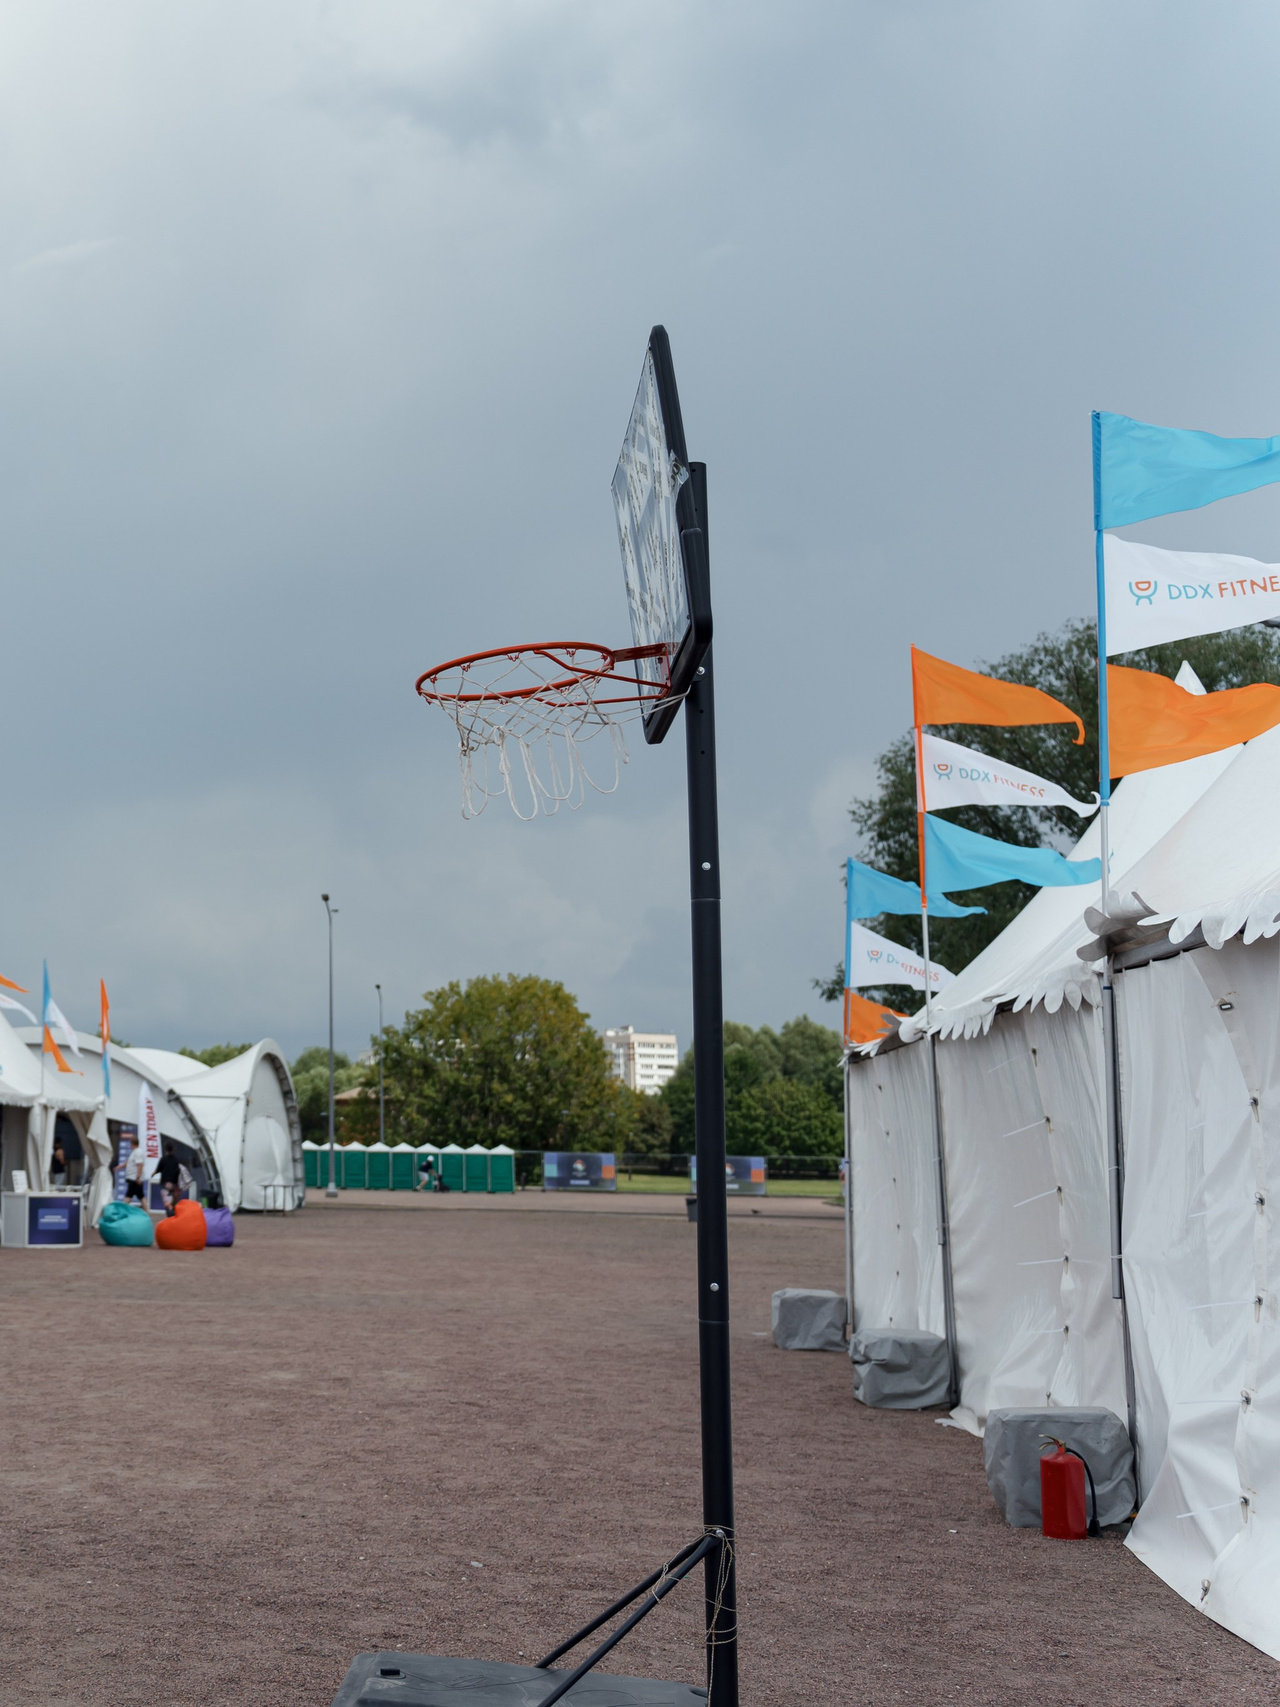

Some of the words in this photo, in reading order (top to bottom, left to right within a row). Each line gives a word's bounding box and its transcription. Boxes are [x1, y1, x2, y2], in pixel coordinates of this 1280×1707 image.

[1167, 583, 1214, 600] DDX
[1218, 575, 1280, 598] FITNE
[959, 767, 991, 782] DDX
[146, 1134, 159, 1158] MEN
